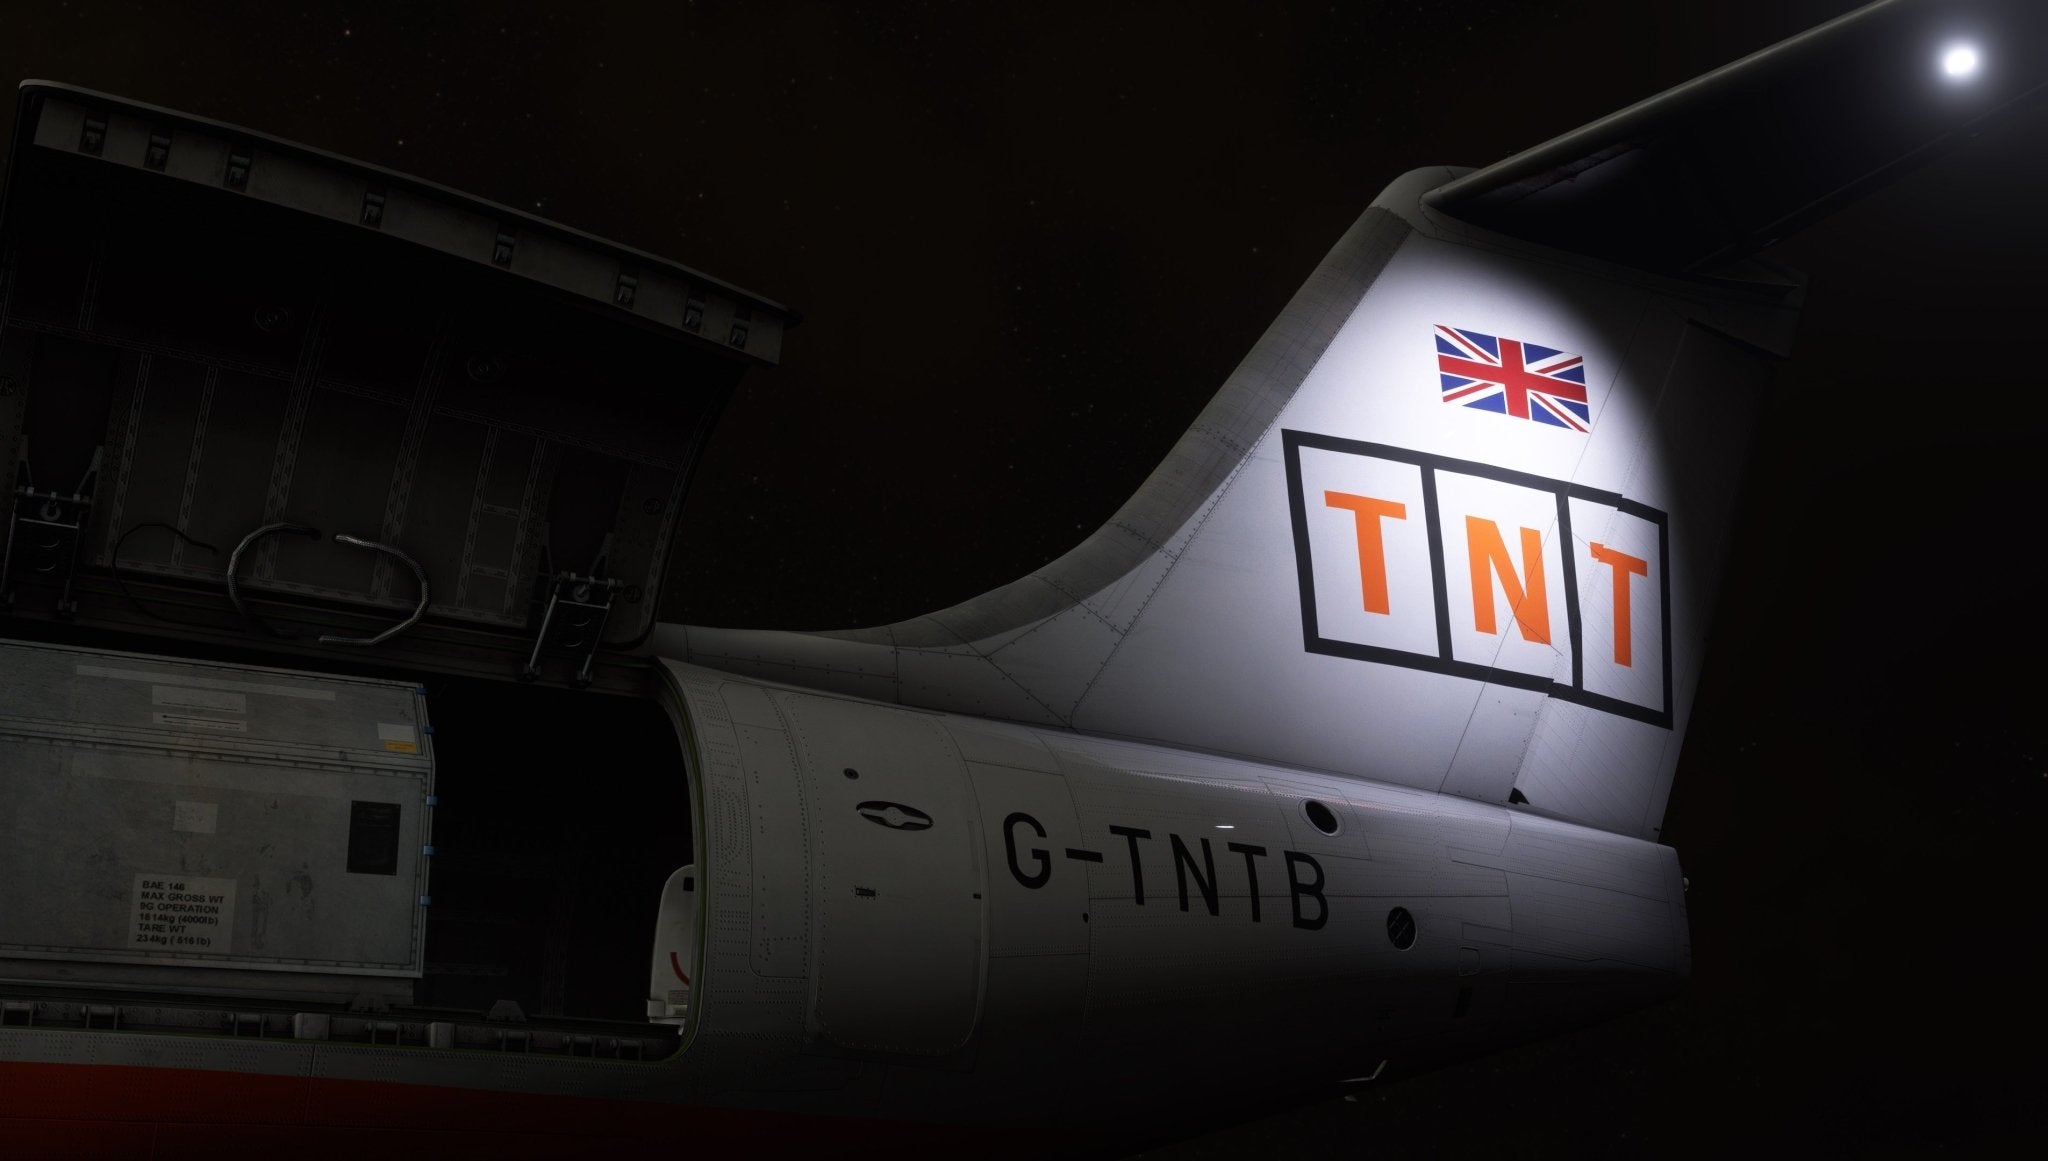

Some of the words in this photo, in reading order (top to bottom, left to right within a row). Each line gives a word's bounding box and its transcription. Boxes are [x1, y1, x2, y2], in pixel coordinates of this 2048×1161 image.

[1324, 490, 1648, 668] TNT
[1003, 812, 1329, 931] G-TNTB
[142, 880, 164, 890] BAE
[168, 883, 185, 891] 146
[141, 891, 165, 900] MAX
[167, 893, 206, 903] GROSS
[208, 895, 225, 904] WT
[157, 903, 219, 914] OPERATION
[138, 923, 166, 932] TARE
[168, 925, 186, 933] WT
